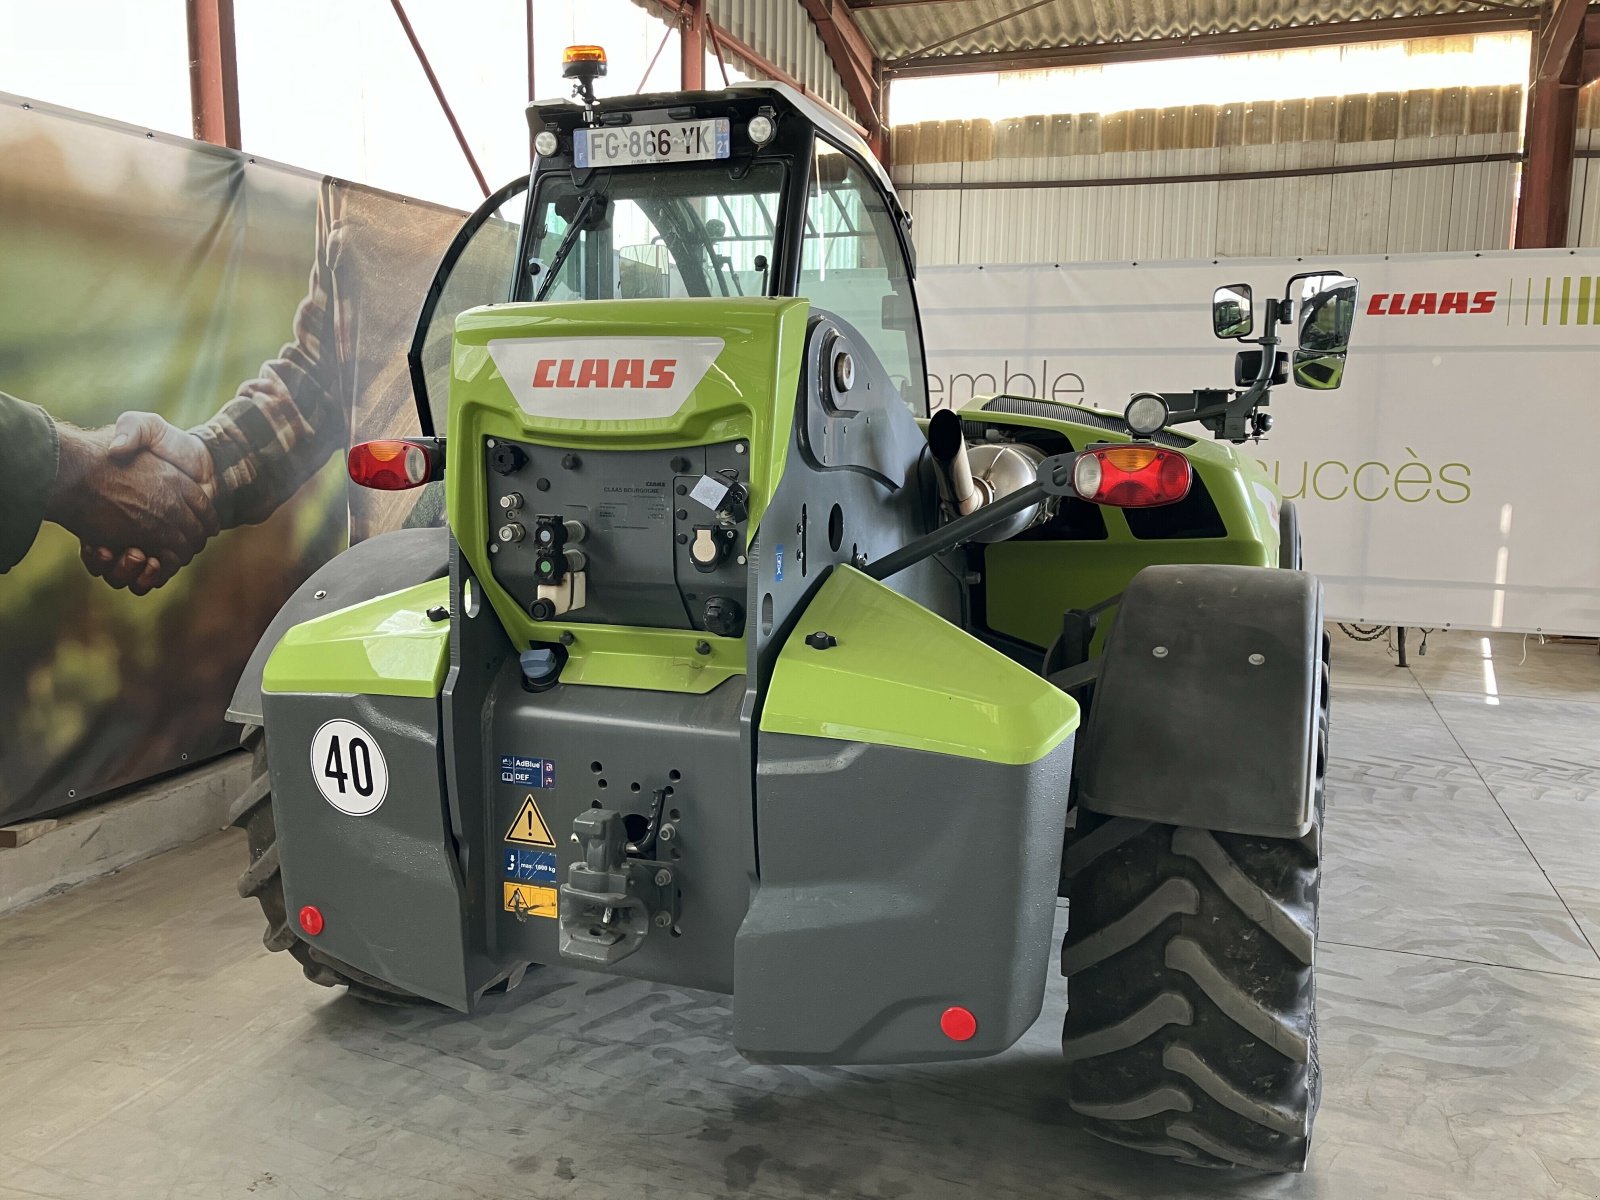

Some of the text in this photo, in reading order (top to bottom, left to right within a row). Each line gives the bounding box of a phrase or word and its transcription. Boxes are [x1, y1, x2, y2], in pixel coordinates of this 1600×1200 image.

[716, 140, 729, 154] 21
[1366, 291, 1498, 315] CLAAS
[532, 359, 677, 388] CLAAS
[1256, 446, 1472, 504] uccès
[325, 735, 374, 797] 40
[515, 759, 541, 769] AdBlue
[515, 773, 530, 781] DEF
[548, 866, 556, 874] kg
